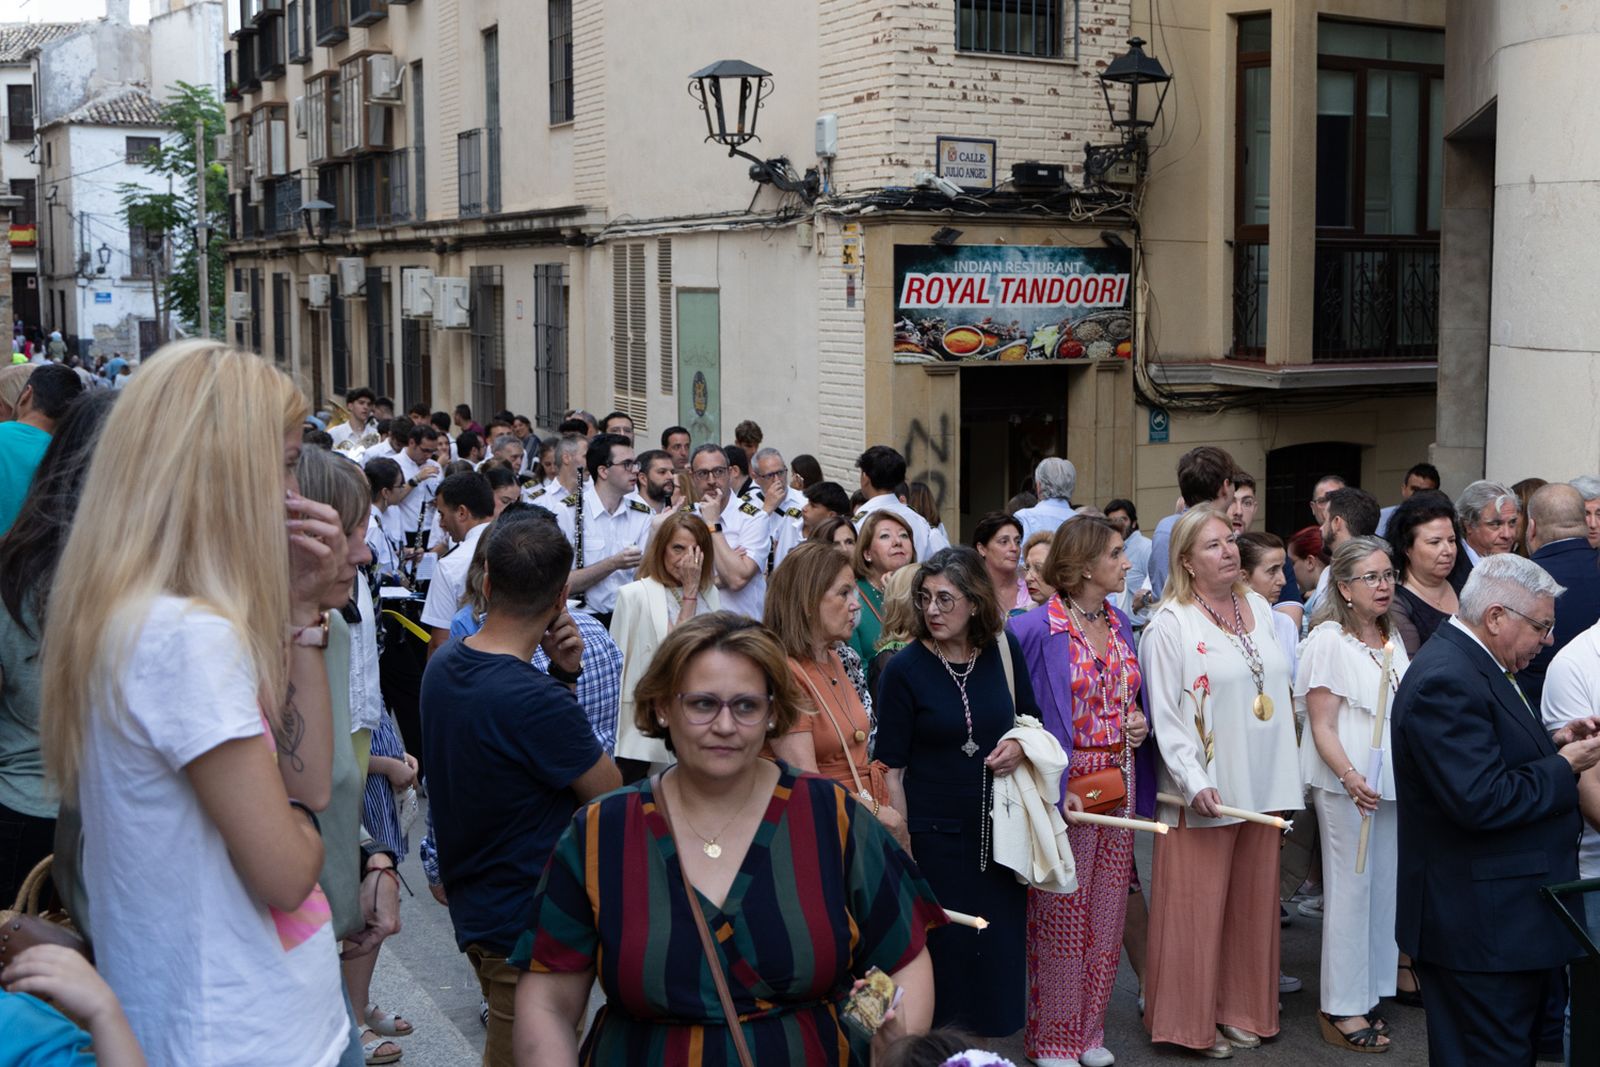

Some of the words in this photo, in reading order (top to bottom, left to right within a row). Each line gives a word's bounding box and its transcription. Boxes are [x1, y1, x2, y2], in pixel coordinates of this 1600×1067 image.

[959, 152, 986, 163] CALLE
[944, 166, 964, 178] JULIO
[965, 168, 987, 179] ANGEL
[954, 261, 1002, 273] INDIAN
[1006, 261, 1083, 273] RESTURANT
[905, 277, 990, 304] ROYAL
[1000, 277, 1125, 304] TANDOORI
